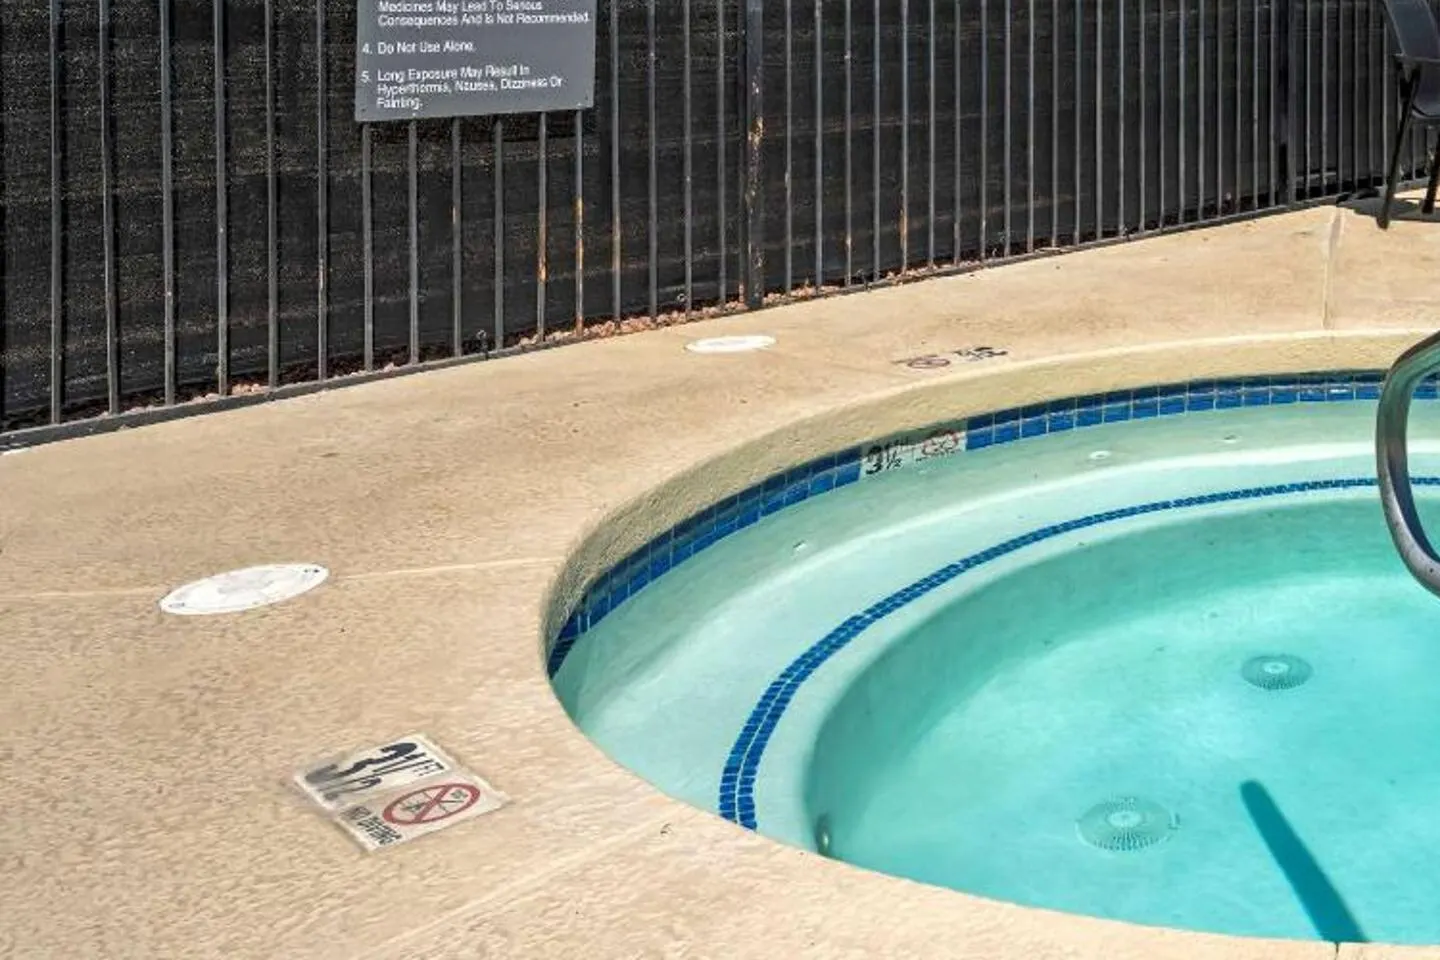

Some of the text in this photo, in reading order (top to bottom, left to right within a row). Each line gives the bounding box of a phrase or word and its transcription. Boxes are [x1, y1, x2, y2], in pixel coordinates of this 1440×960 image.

[378, 0, 433, 13] Medicines
[435, 0, 459, 15] May
[461, 0, 486, 13] Lead
[489, 0, 504, 12] To
[378, 14, 459, 29] Consequences
[461, 13, 483, 26] And
[485, 13, 494, 25] Is
[496, 12, 514, 25] Not
[377, 41, 395, 55] Do
[396, 41, 416, 54] Not
[420, 41, 441, 53] Use
[377, 69, 404, 84] Long
[407, 67, 458, 82] Exposure
[460, 66, 482, 80] May
[485, 64, 518, 78] Result
[520, 64, 530, 76] In
[549, 76, 563, 88] Or
[376, 96, 424, 111] Fainting.
